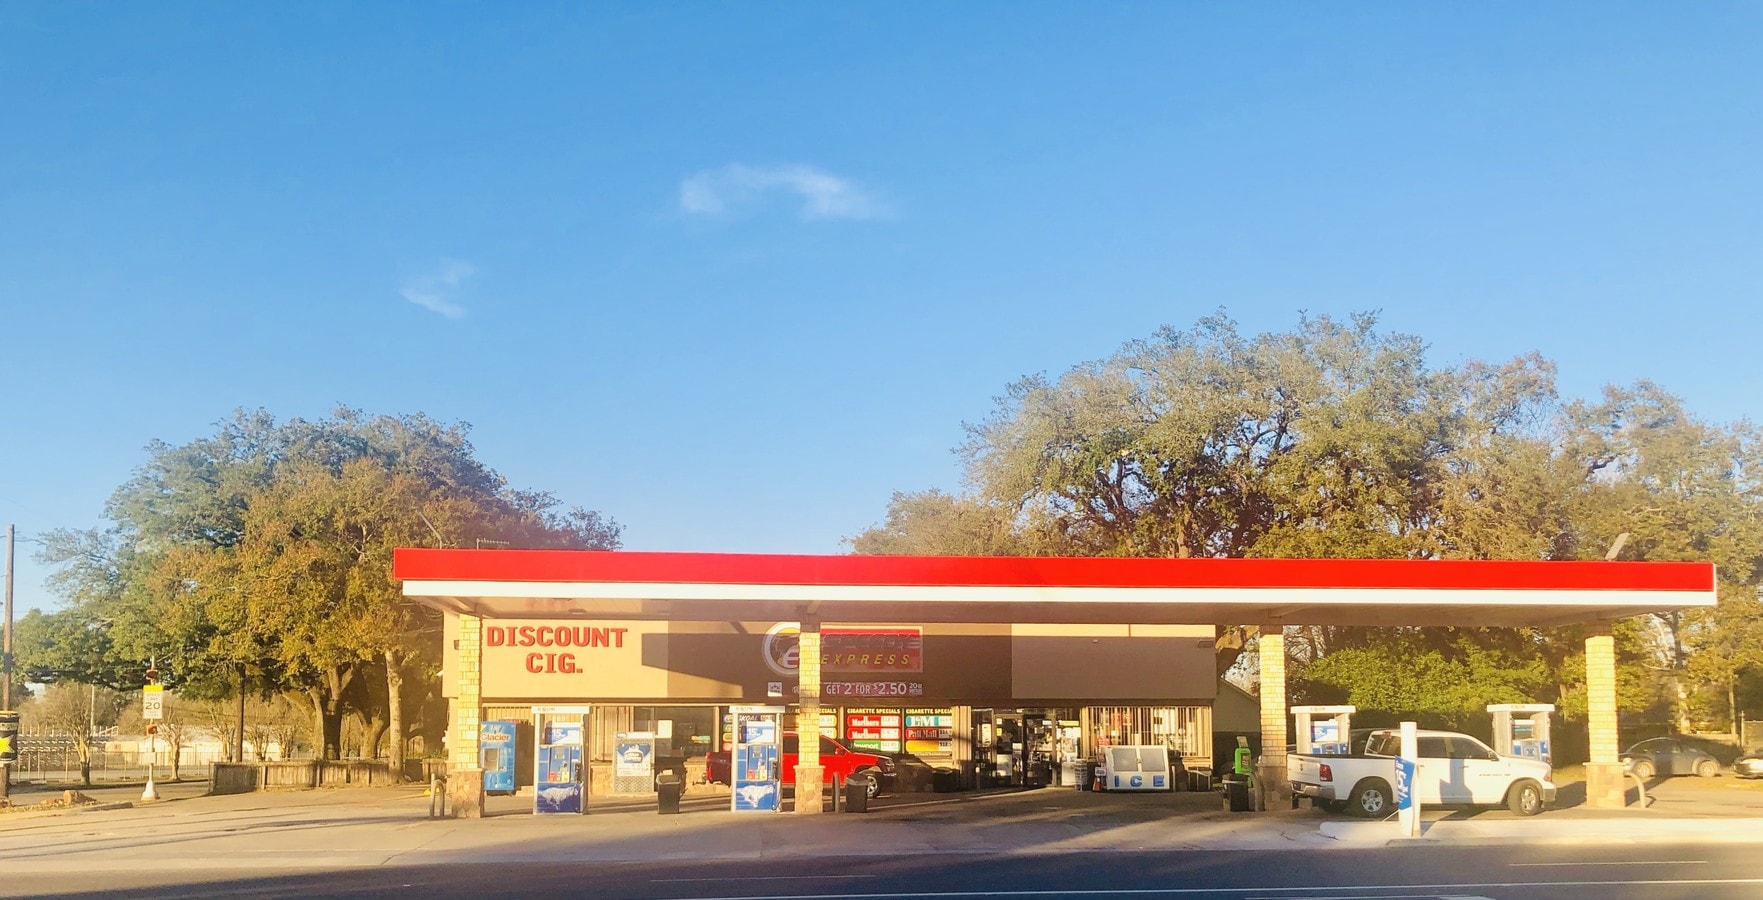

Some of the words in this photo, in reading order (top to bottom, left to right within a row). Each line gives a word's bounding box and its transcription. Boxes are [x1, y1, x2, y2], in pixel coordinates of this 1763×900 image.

[486, 625, 629, 648] DISCOUNT
[525, 652, 583, 674] CIG.
[821, 654, 910, 665] EXPRESS
[826, 684, 840, 695] GET
[843, 683, 852, 695] 2
[855, 684, 871, 695] FOR
[873, 682, 907, 696] $2.50
[145, 701, 160, 709] 20
[481, 733, 510, 741] Glacier
[1114, 775, 1165, 788] ICE
